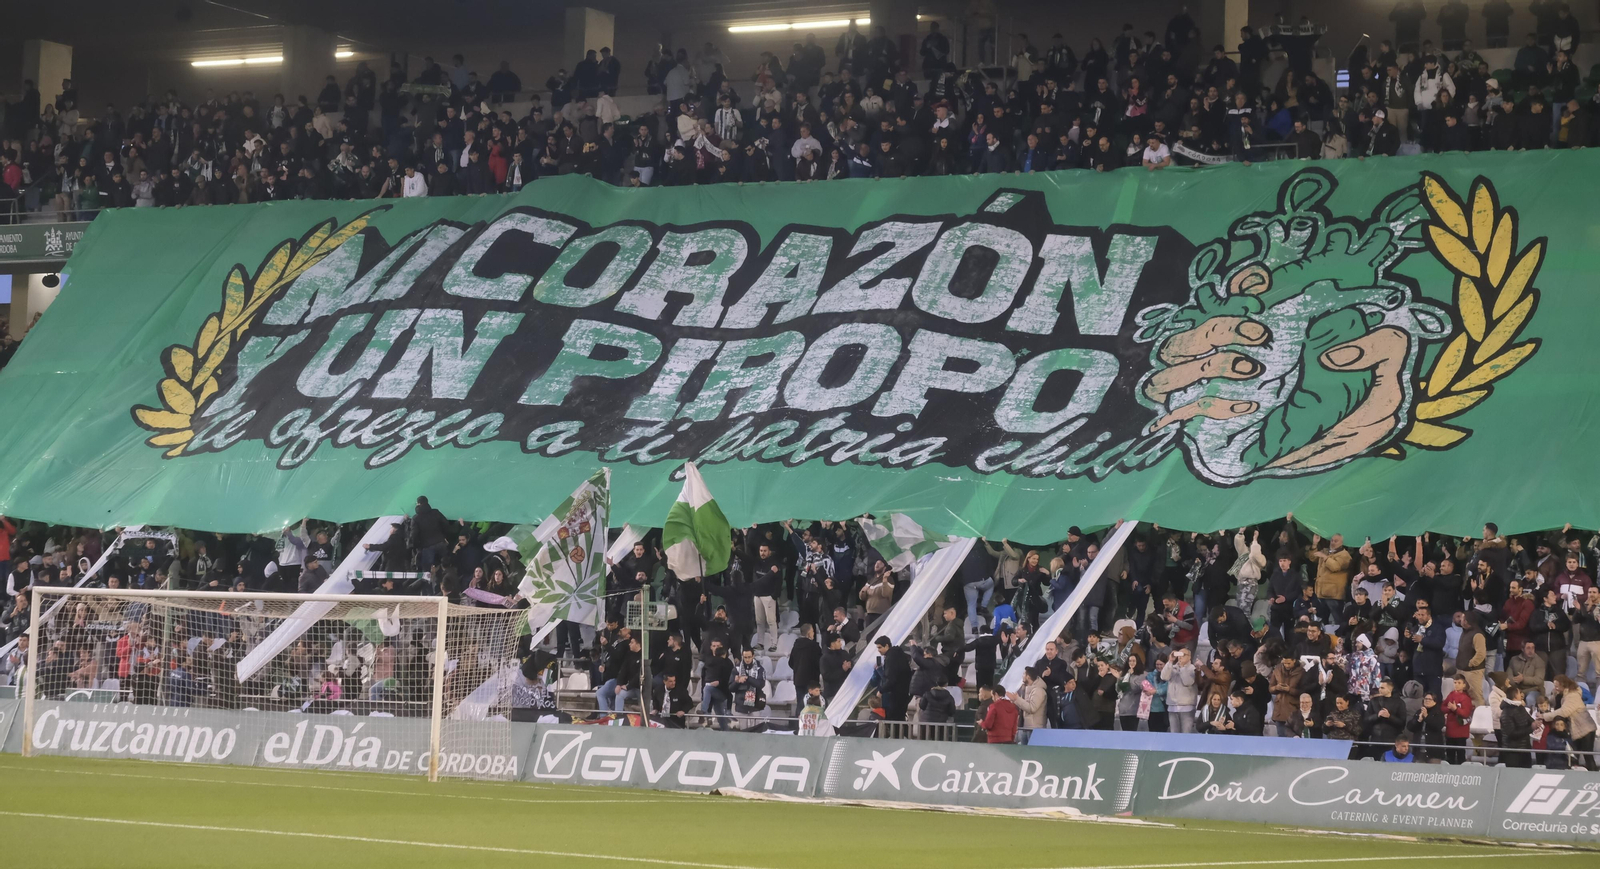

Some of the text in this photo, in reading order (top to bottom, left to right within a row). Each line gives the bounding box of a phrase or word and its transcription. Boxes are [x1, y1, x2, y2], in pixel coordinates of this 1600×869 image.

[262, 192, 1160, 336] MI CORAZÓN
[200, 307, 1119, 434] Y UN PIROPO
[184, 401, 257, 451] te
[269, 379, 505, 467] ofrezco
[526, 420, 586, 455] a
[603, 420, 694, 463] ti
[673, 412, 949, 479] patria
[32, 705, 237, 762] Cruzcampo
[383, 750, 414, 770] DE
[417, 746, 518, 776] CÓRDOBA
[581, 746, 810, 792] GIVOVA
[911, 752, 1105, 800] CaixaBank
[1158, 757, 1479, 811] Doña Carmen
[1391, 770, 1482, 788] carmencatering.com
[1331, 811, 1474, 829] CATERING & EVENT PLANNER
[1570, 822, 1588, 835] de
